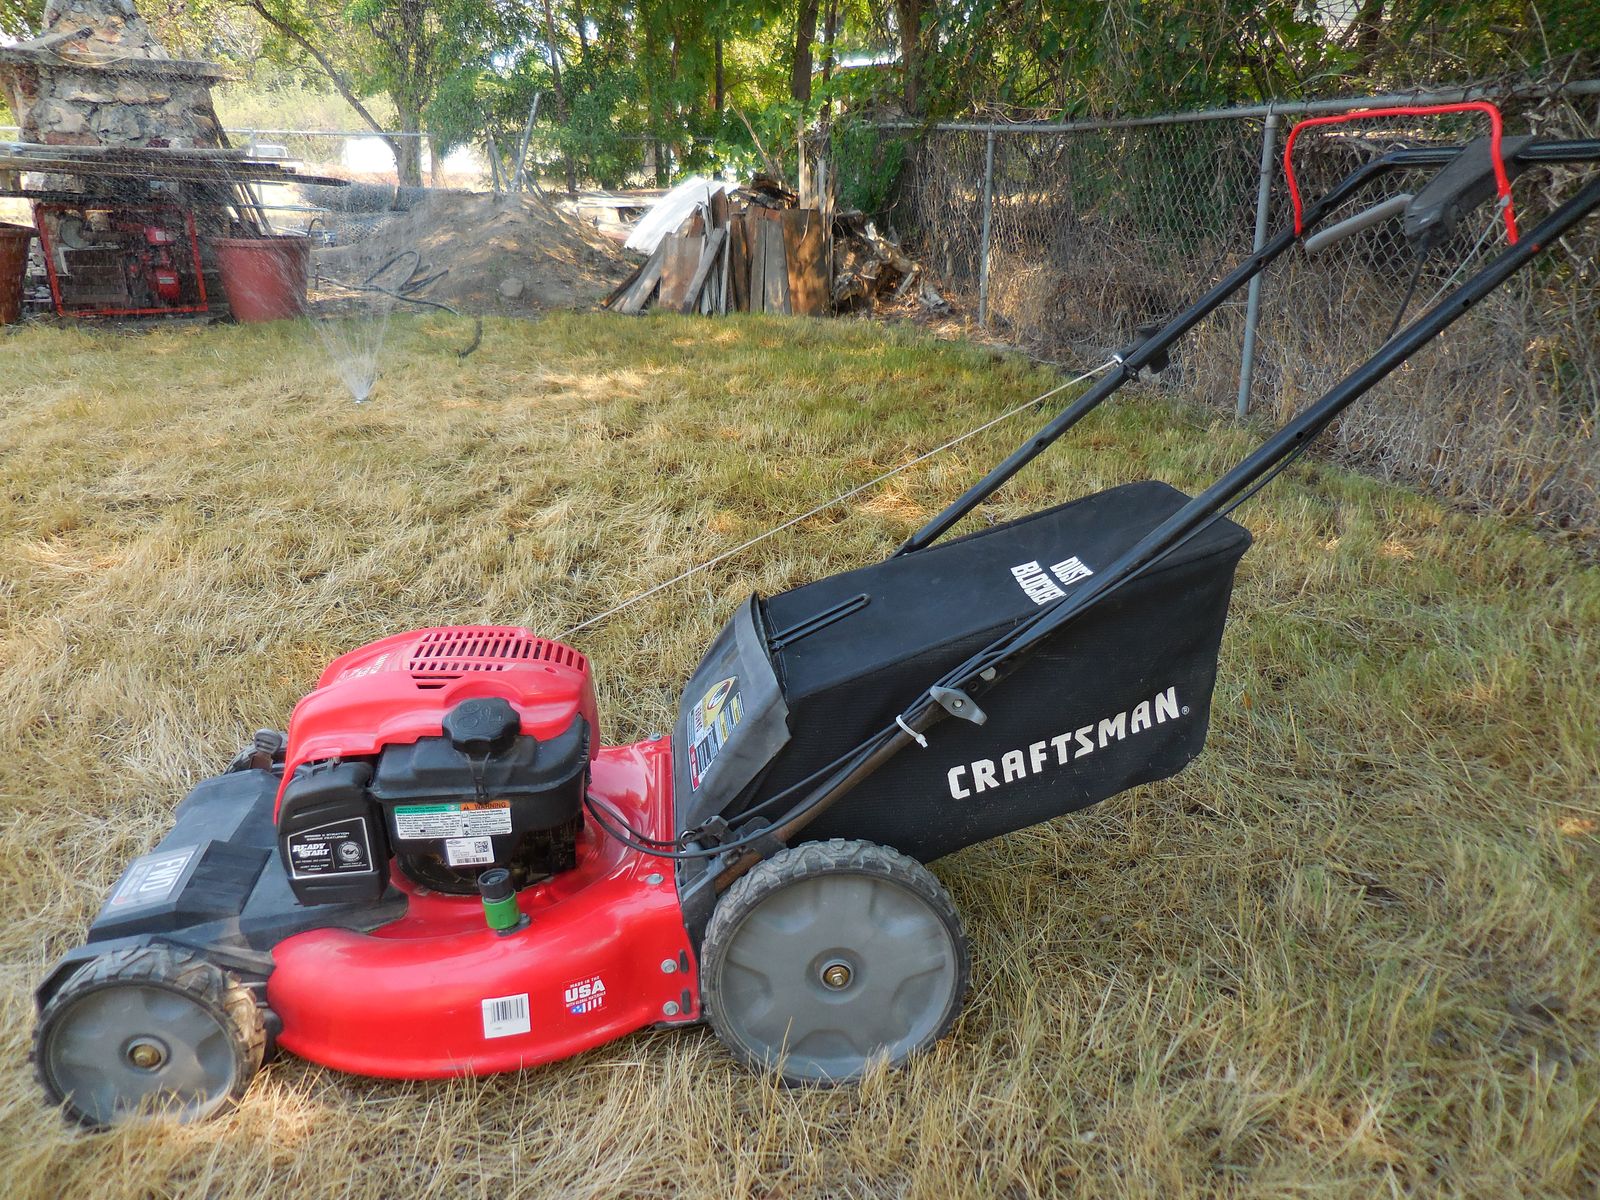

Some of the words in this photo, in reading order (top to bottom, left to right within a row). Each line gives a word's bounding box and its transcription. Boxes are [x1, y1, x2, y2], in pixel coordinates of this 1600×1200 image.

[1049, 555, 1094, 586] DUST
[947, 686, 1180, 800] CRAFTSMAN
[475, 801, 506, 810] WARNING
[292, 843, 326, 852] READY
[300, 849, 330, 858] START
[139, 857, 187, 892] FWD
[565, 979, 606, 1003] USA
